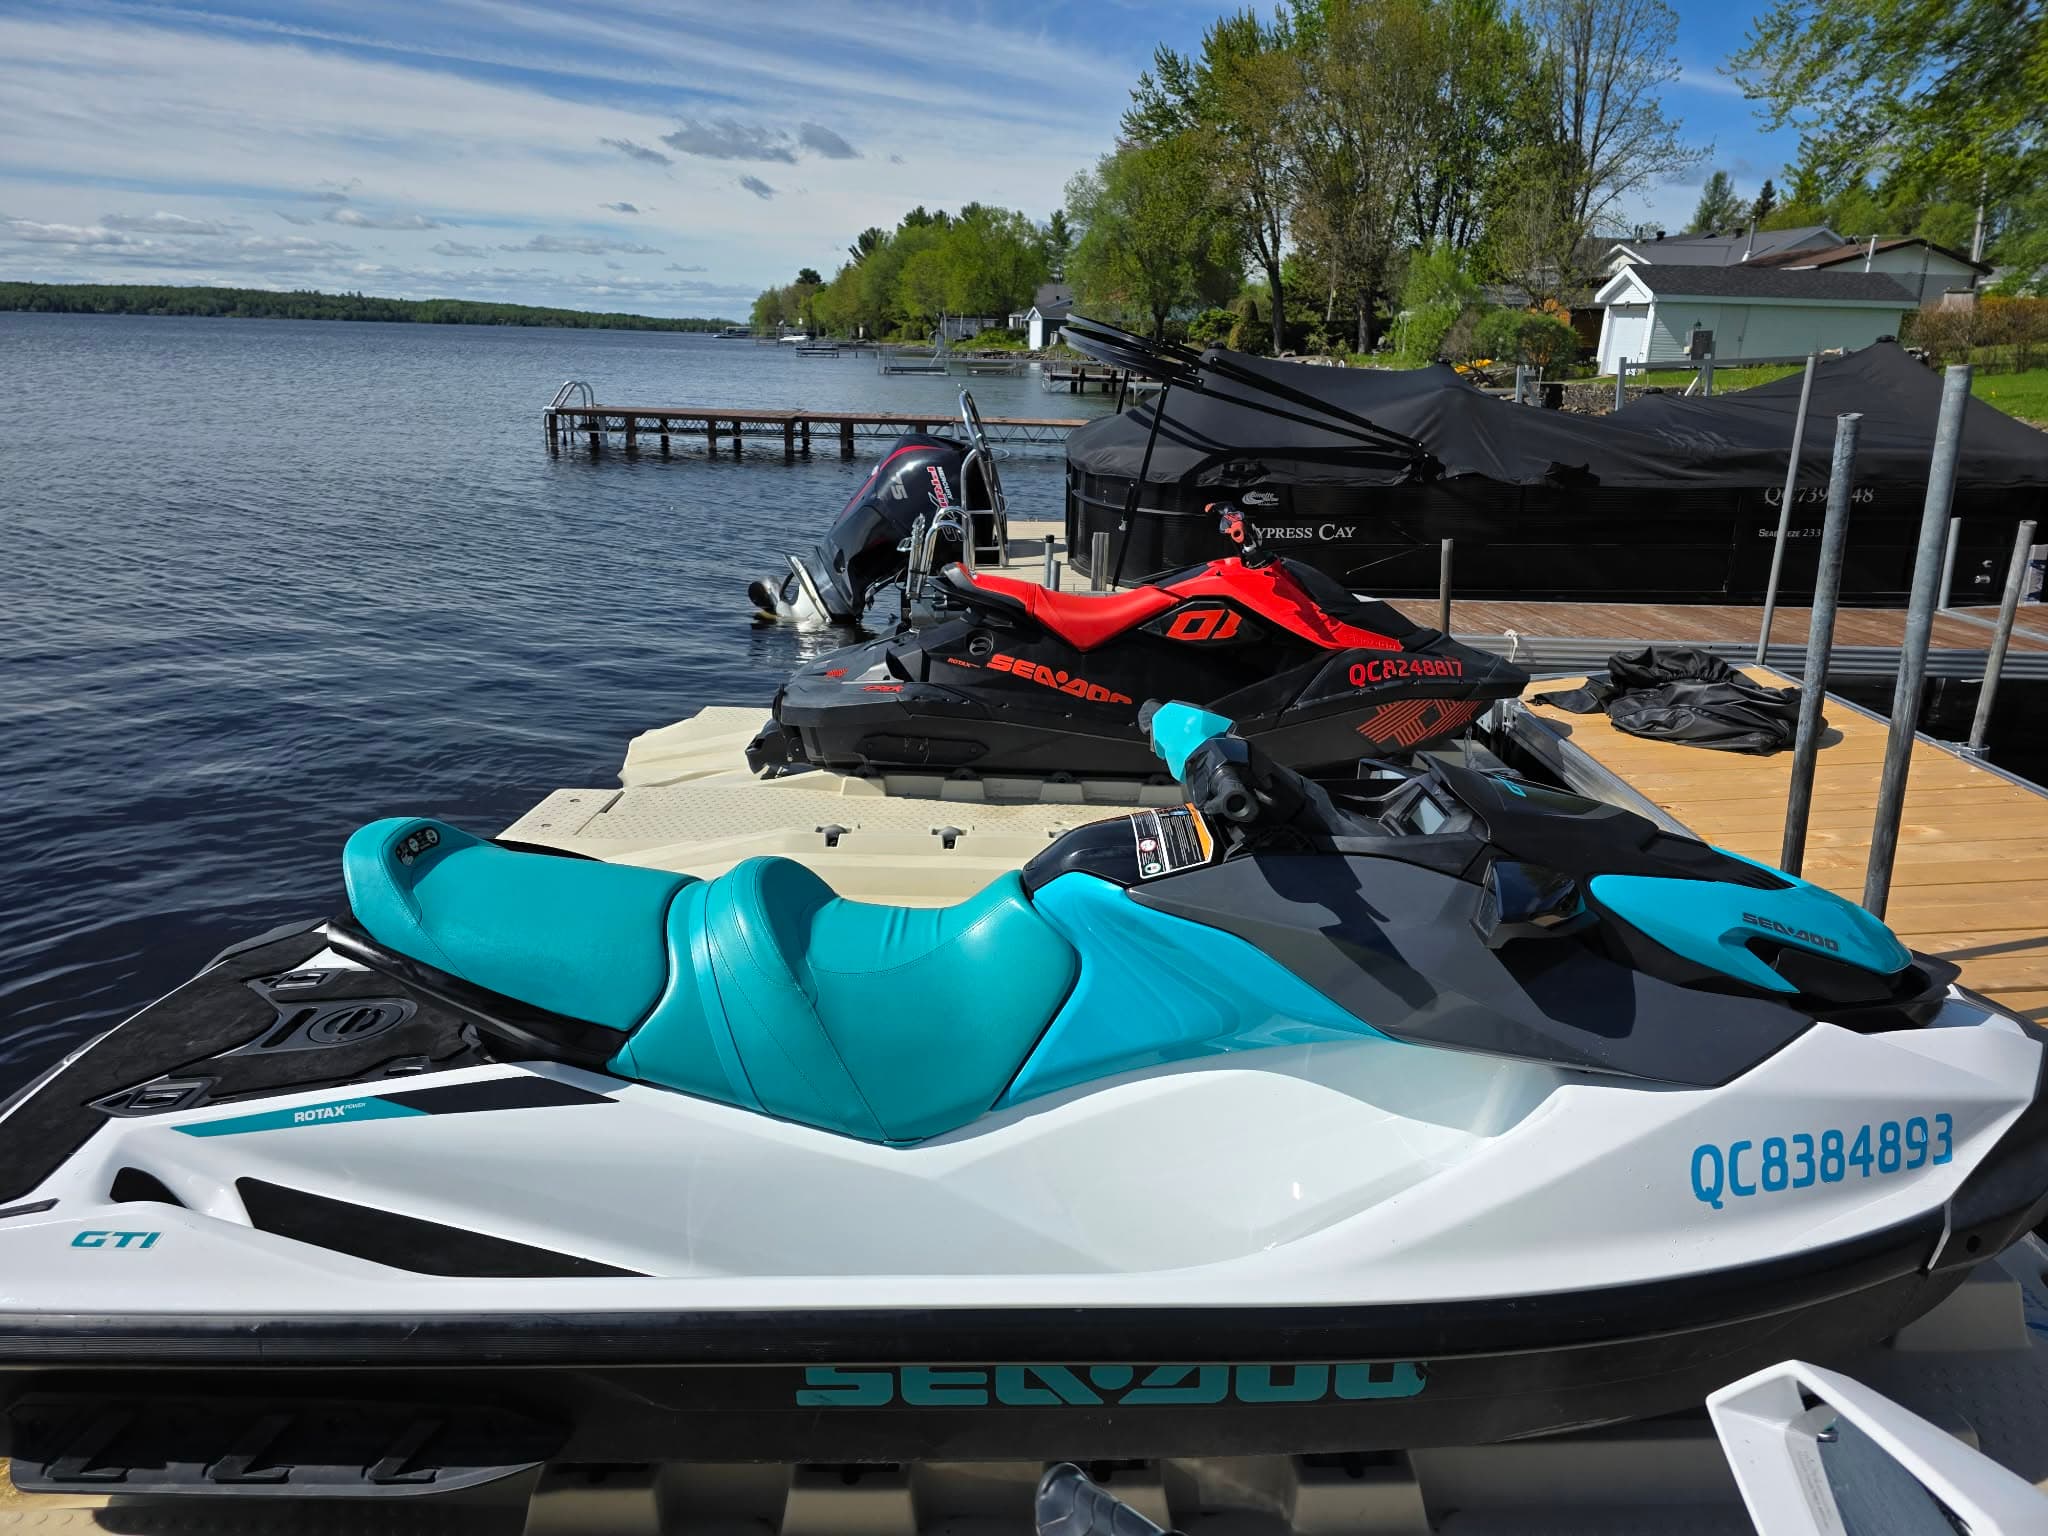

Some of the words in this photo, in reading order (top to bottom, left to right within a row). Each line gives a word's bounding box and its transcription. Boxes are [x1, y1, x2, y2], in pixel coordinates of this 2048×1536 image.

[1254, 526, 1313, 539] YPRESS
[1318, 523, 1357, 541] CAY
[294, 1104, 345, 1123] ROTAX
[1691, 1113, 1953, 1210] QC8384893
[71, 1231, 162, 1249] GTI
